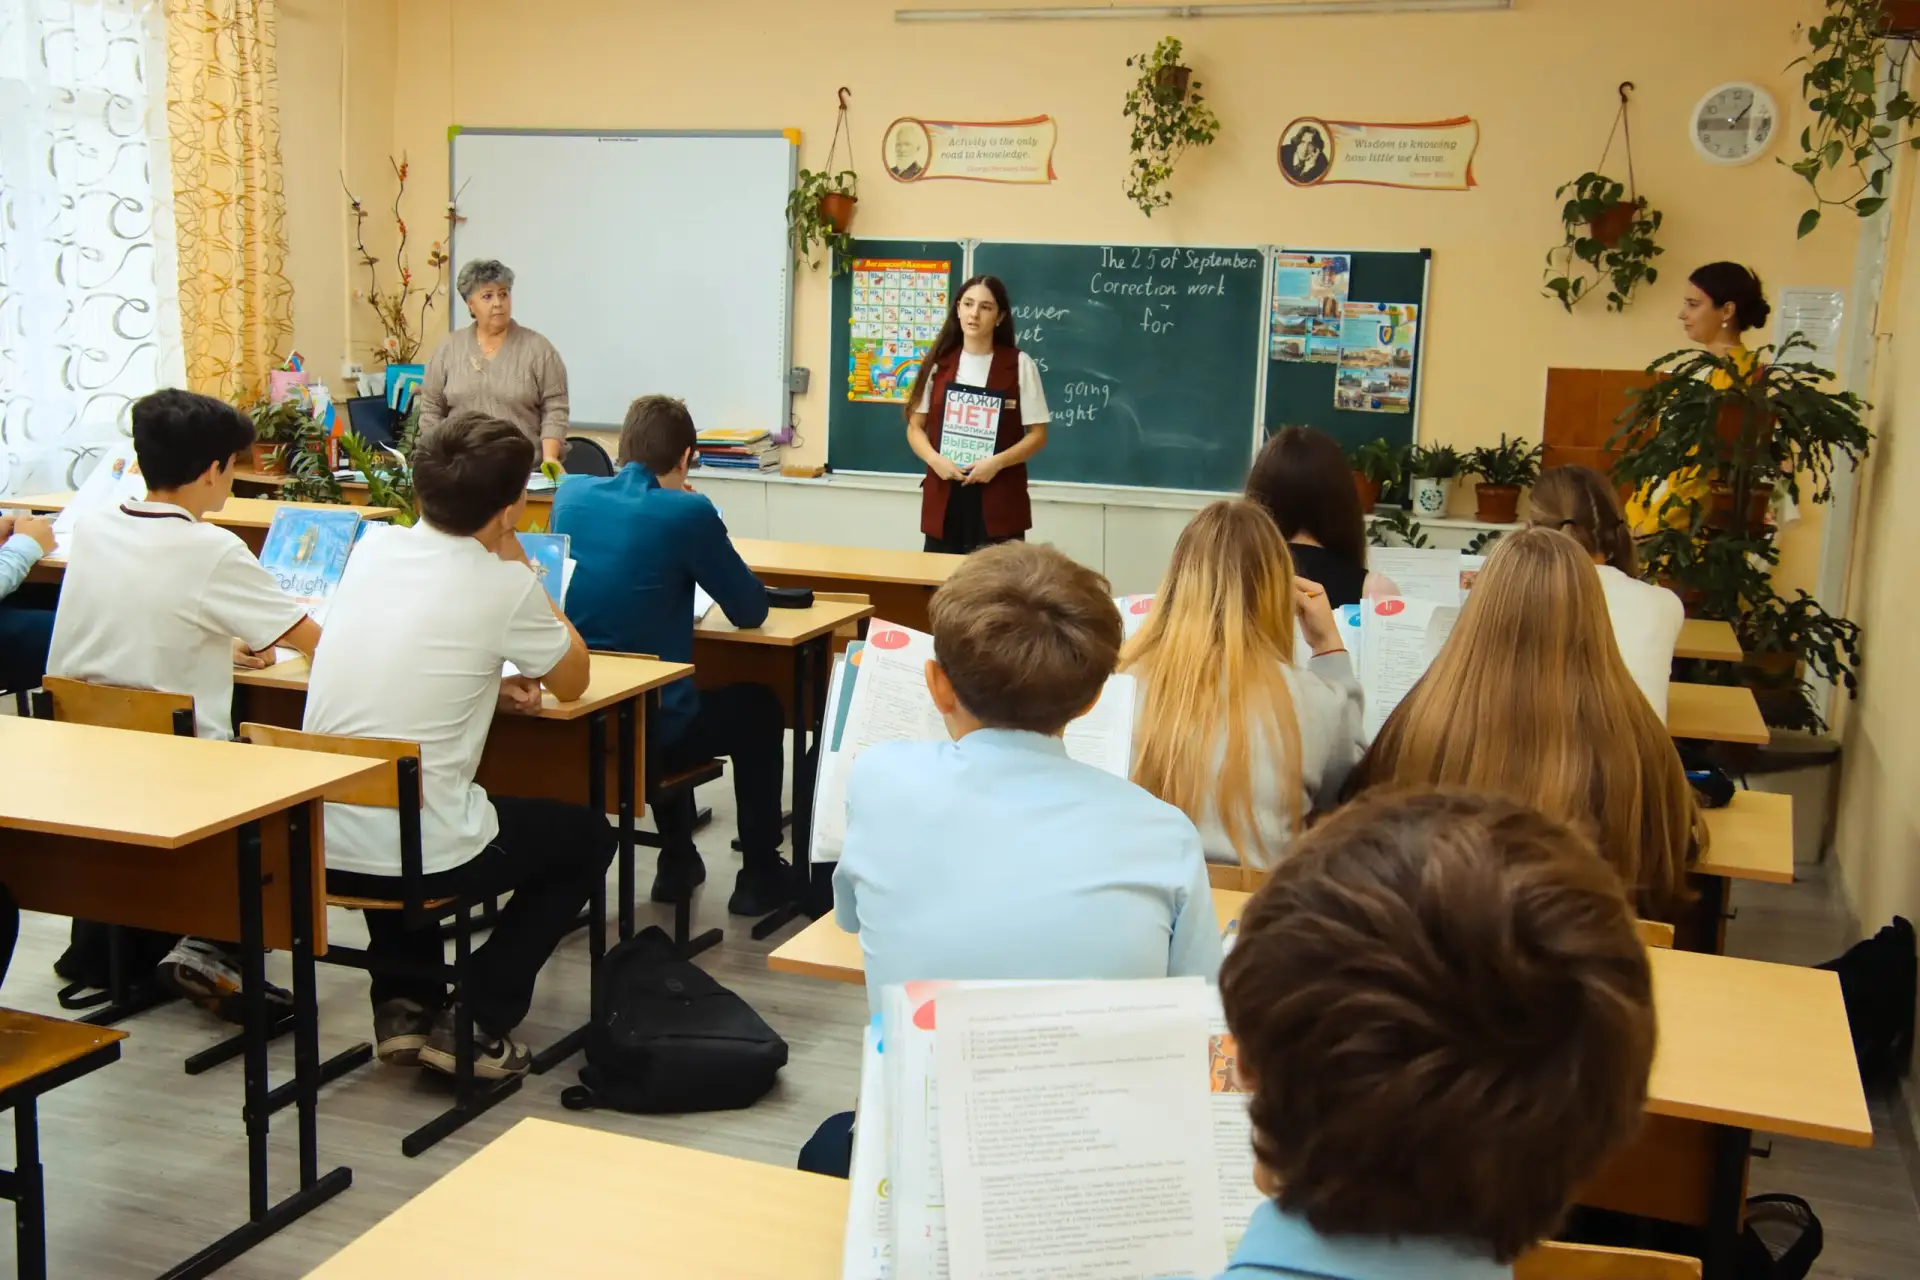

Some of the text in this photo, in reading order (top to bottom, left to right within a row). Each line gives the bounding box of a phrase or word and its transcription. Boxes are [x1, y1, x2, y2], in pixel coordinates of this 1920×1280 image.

[948, 136, 1038, 147] Activity is the only
[1354, 139, 1458, 150] Wisdom is knowing
[941, 150, 963, 160] road
[965, 150, 975, 159] to
[1345, 152, 1367, 163] how
[1368, 152, 1394, 163] little
[1397, 154, 1412, 163] we
[1100, 246, 1127, 269] The
[1131, 247, 1160, 270] 25
[1160, 247, 1180, 270] of
[1090, 272, 1225, 297] Correction work
[1139, 307, 1175, 334] for
[948, 391, 1001, 409] СКАЖИ
[1064, 382, 1110, 408] going
[945, 401, 999, 429] НЕТ
[944, 423, 996, 437] НАРКОТИКАМ
[942, 435, 994, 453] ВЫБЕРИ
[942, 447, 988, 463] ЖИЗН
